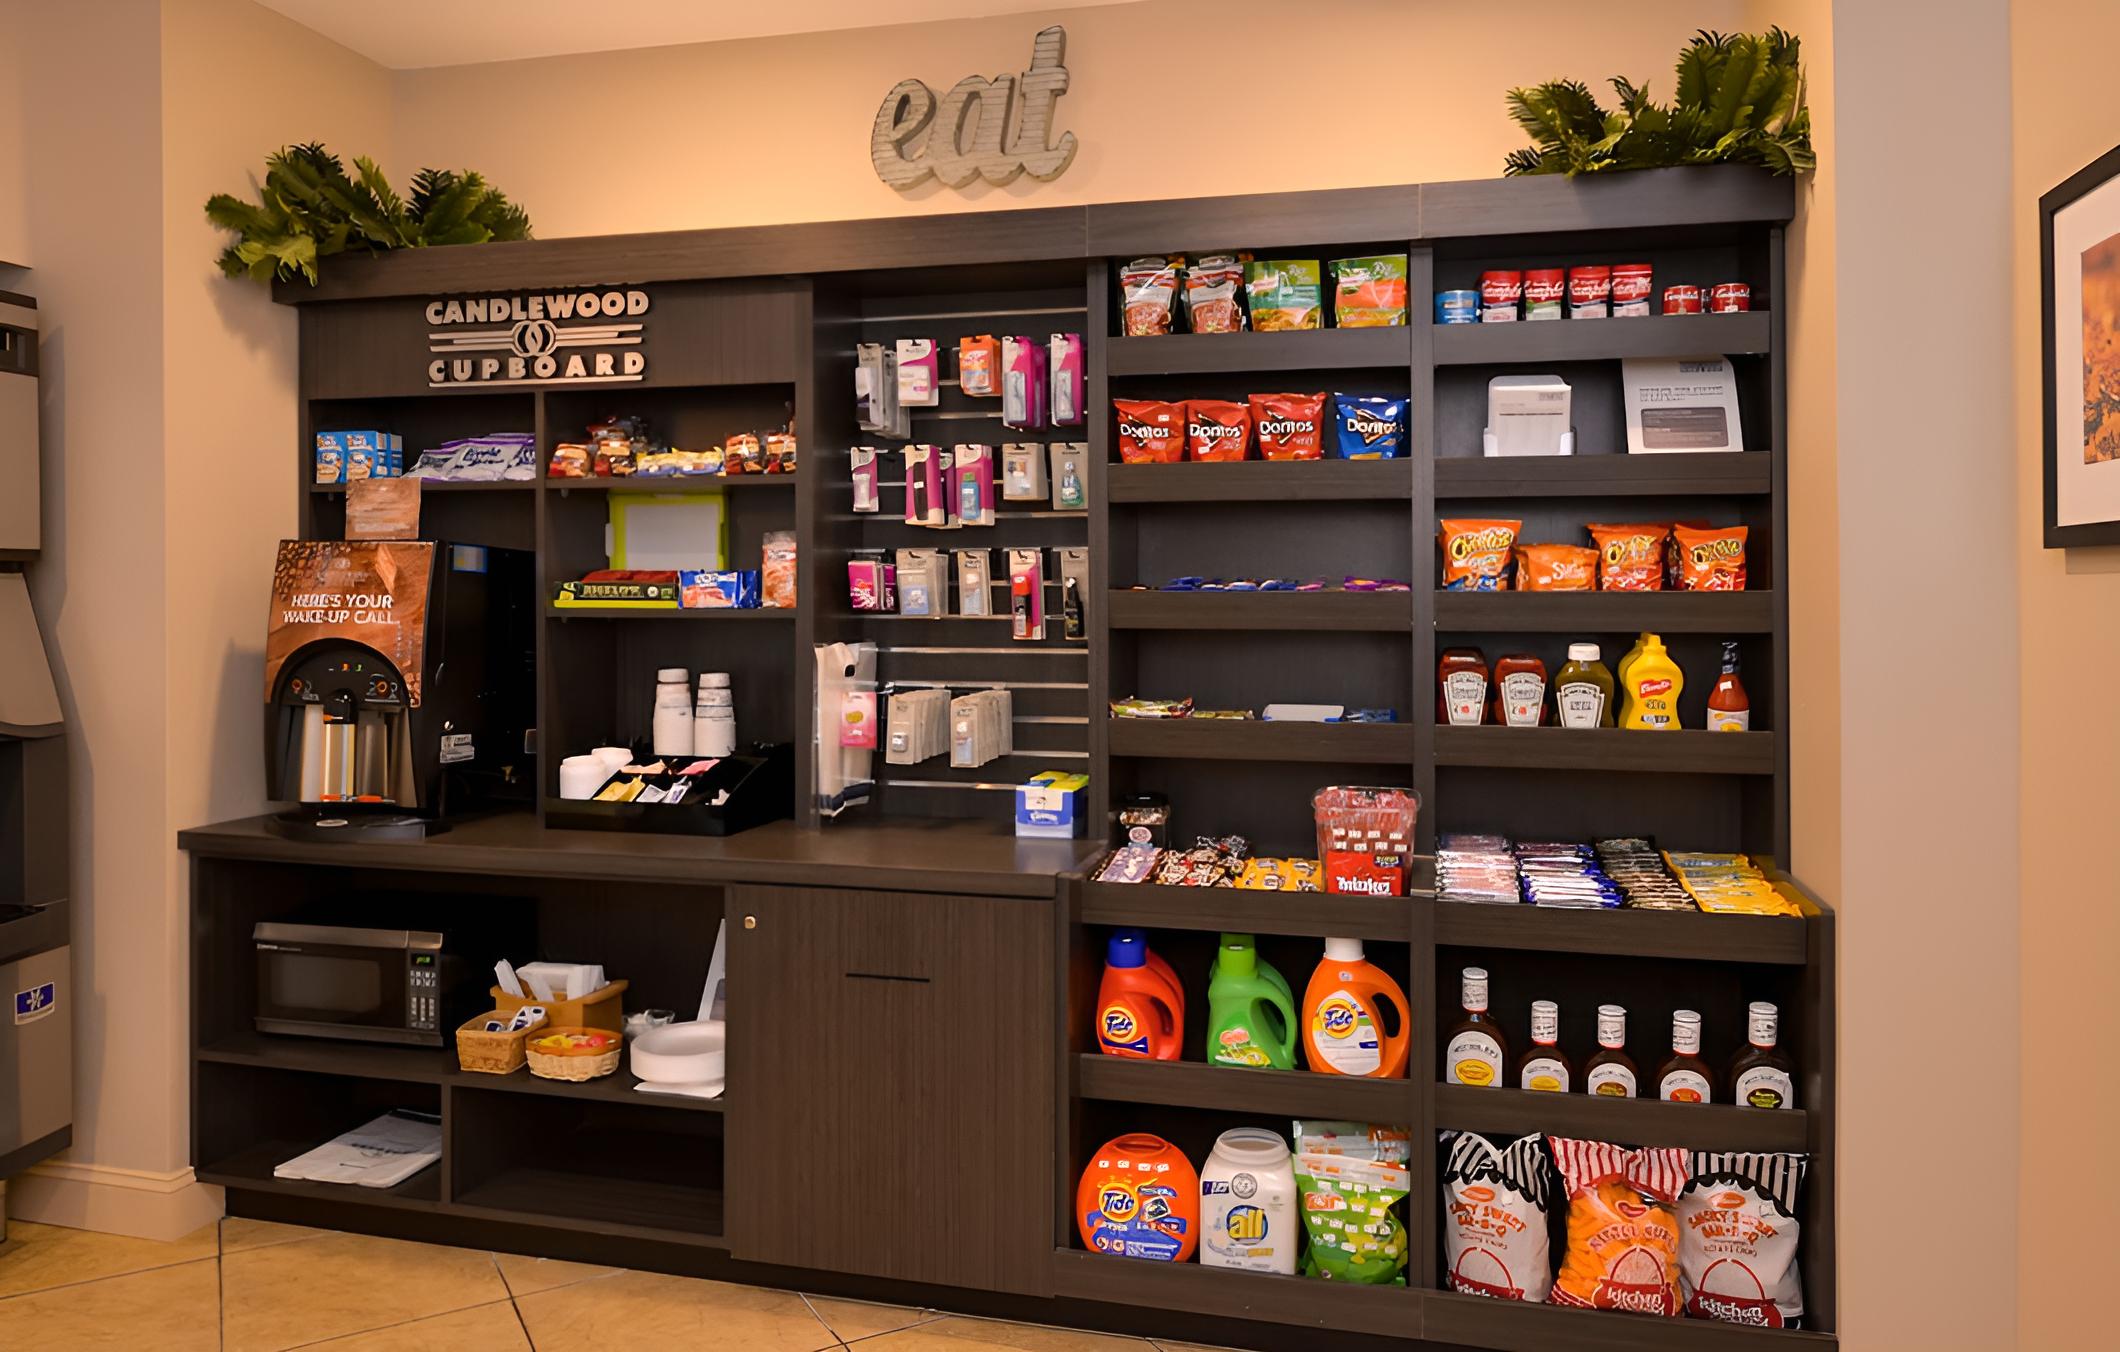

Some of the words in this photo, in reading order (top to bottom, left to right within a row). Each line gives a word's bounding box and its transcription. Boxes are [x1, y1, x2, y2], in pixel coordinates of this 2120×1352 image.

[871, 25, 1078, 190] eat
[425, 291, 649, 325] CANDLEWOOD
[428, 352, 645, 382] CUPBOARD
[1260, 421, 1313, 434] Doritos
[346, 593, 394, 608] YOUR
[1229, 1209, 1264, 1239] all
